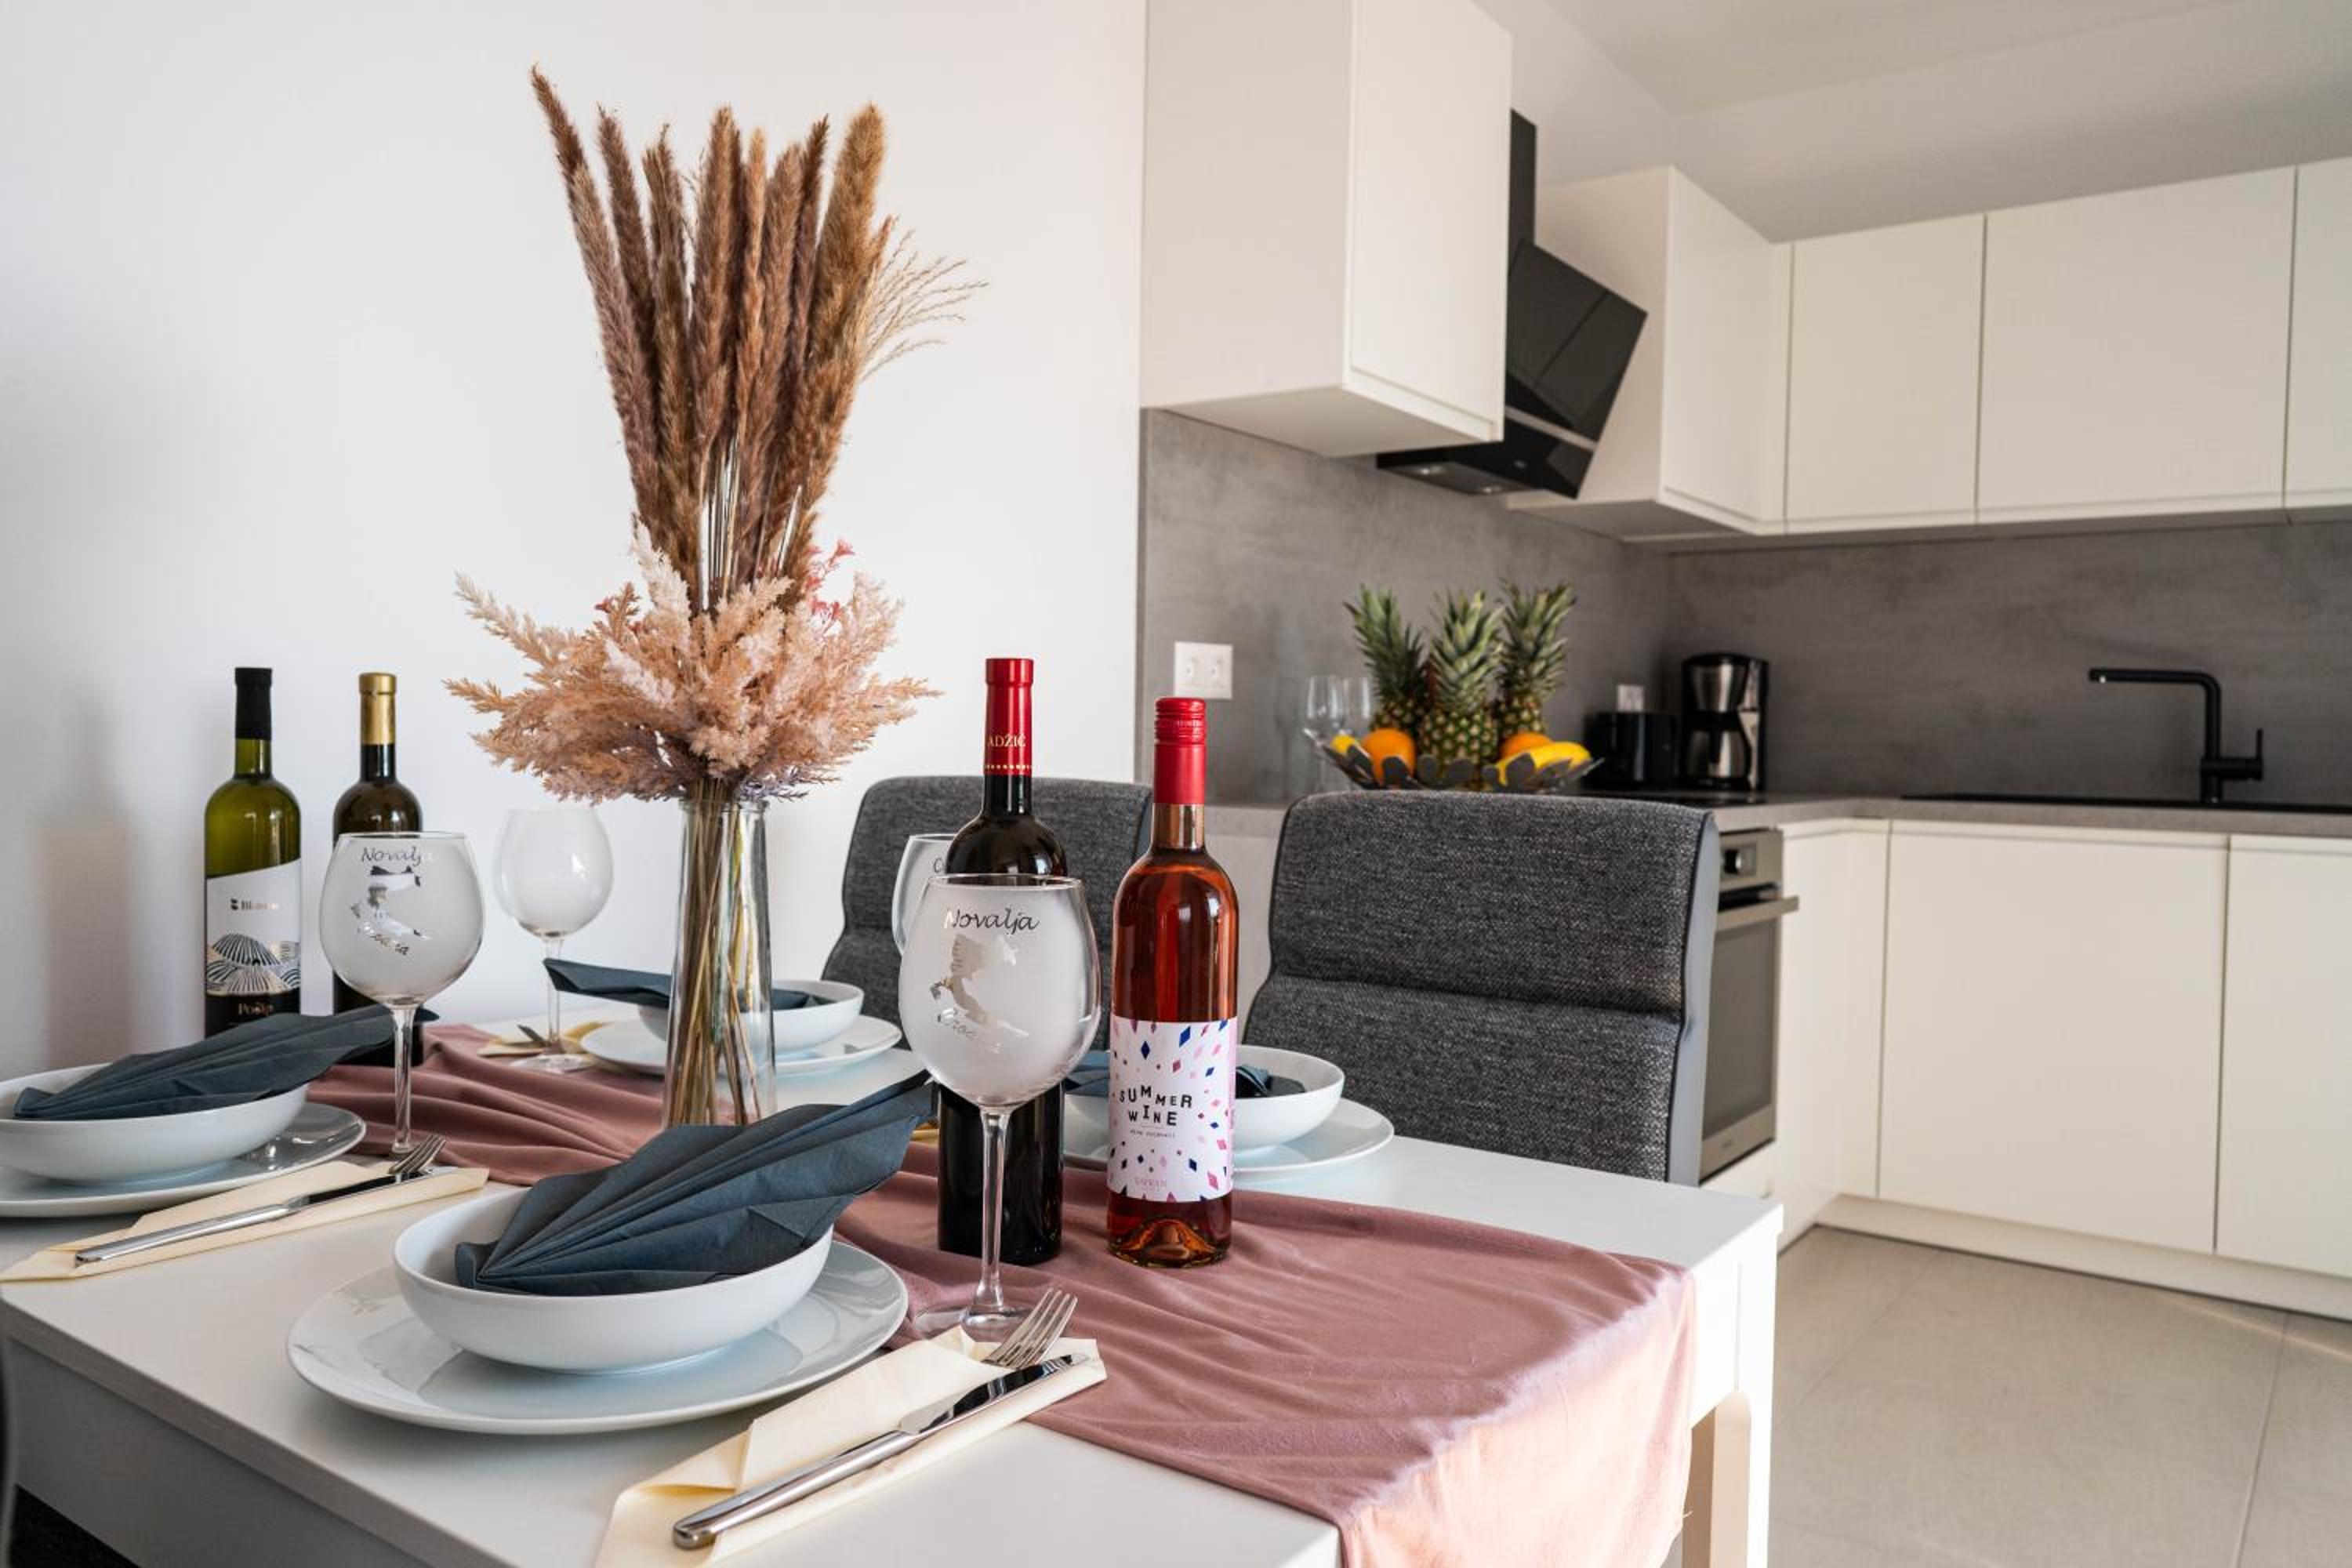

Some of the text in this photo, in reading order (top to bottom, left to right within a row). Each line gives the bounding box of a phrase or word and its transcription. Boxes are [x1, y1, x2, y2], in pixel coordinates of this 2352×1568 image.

[361, 846, 434, 867] Novalj
[943, 907, 1040, 935] Novalja
[1119, 1084, 1192, 1108] SUMMER
[1127, 1105, 1178, 1126] WINE
